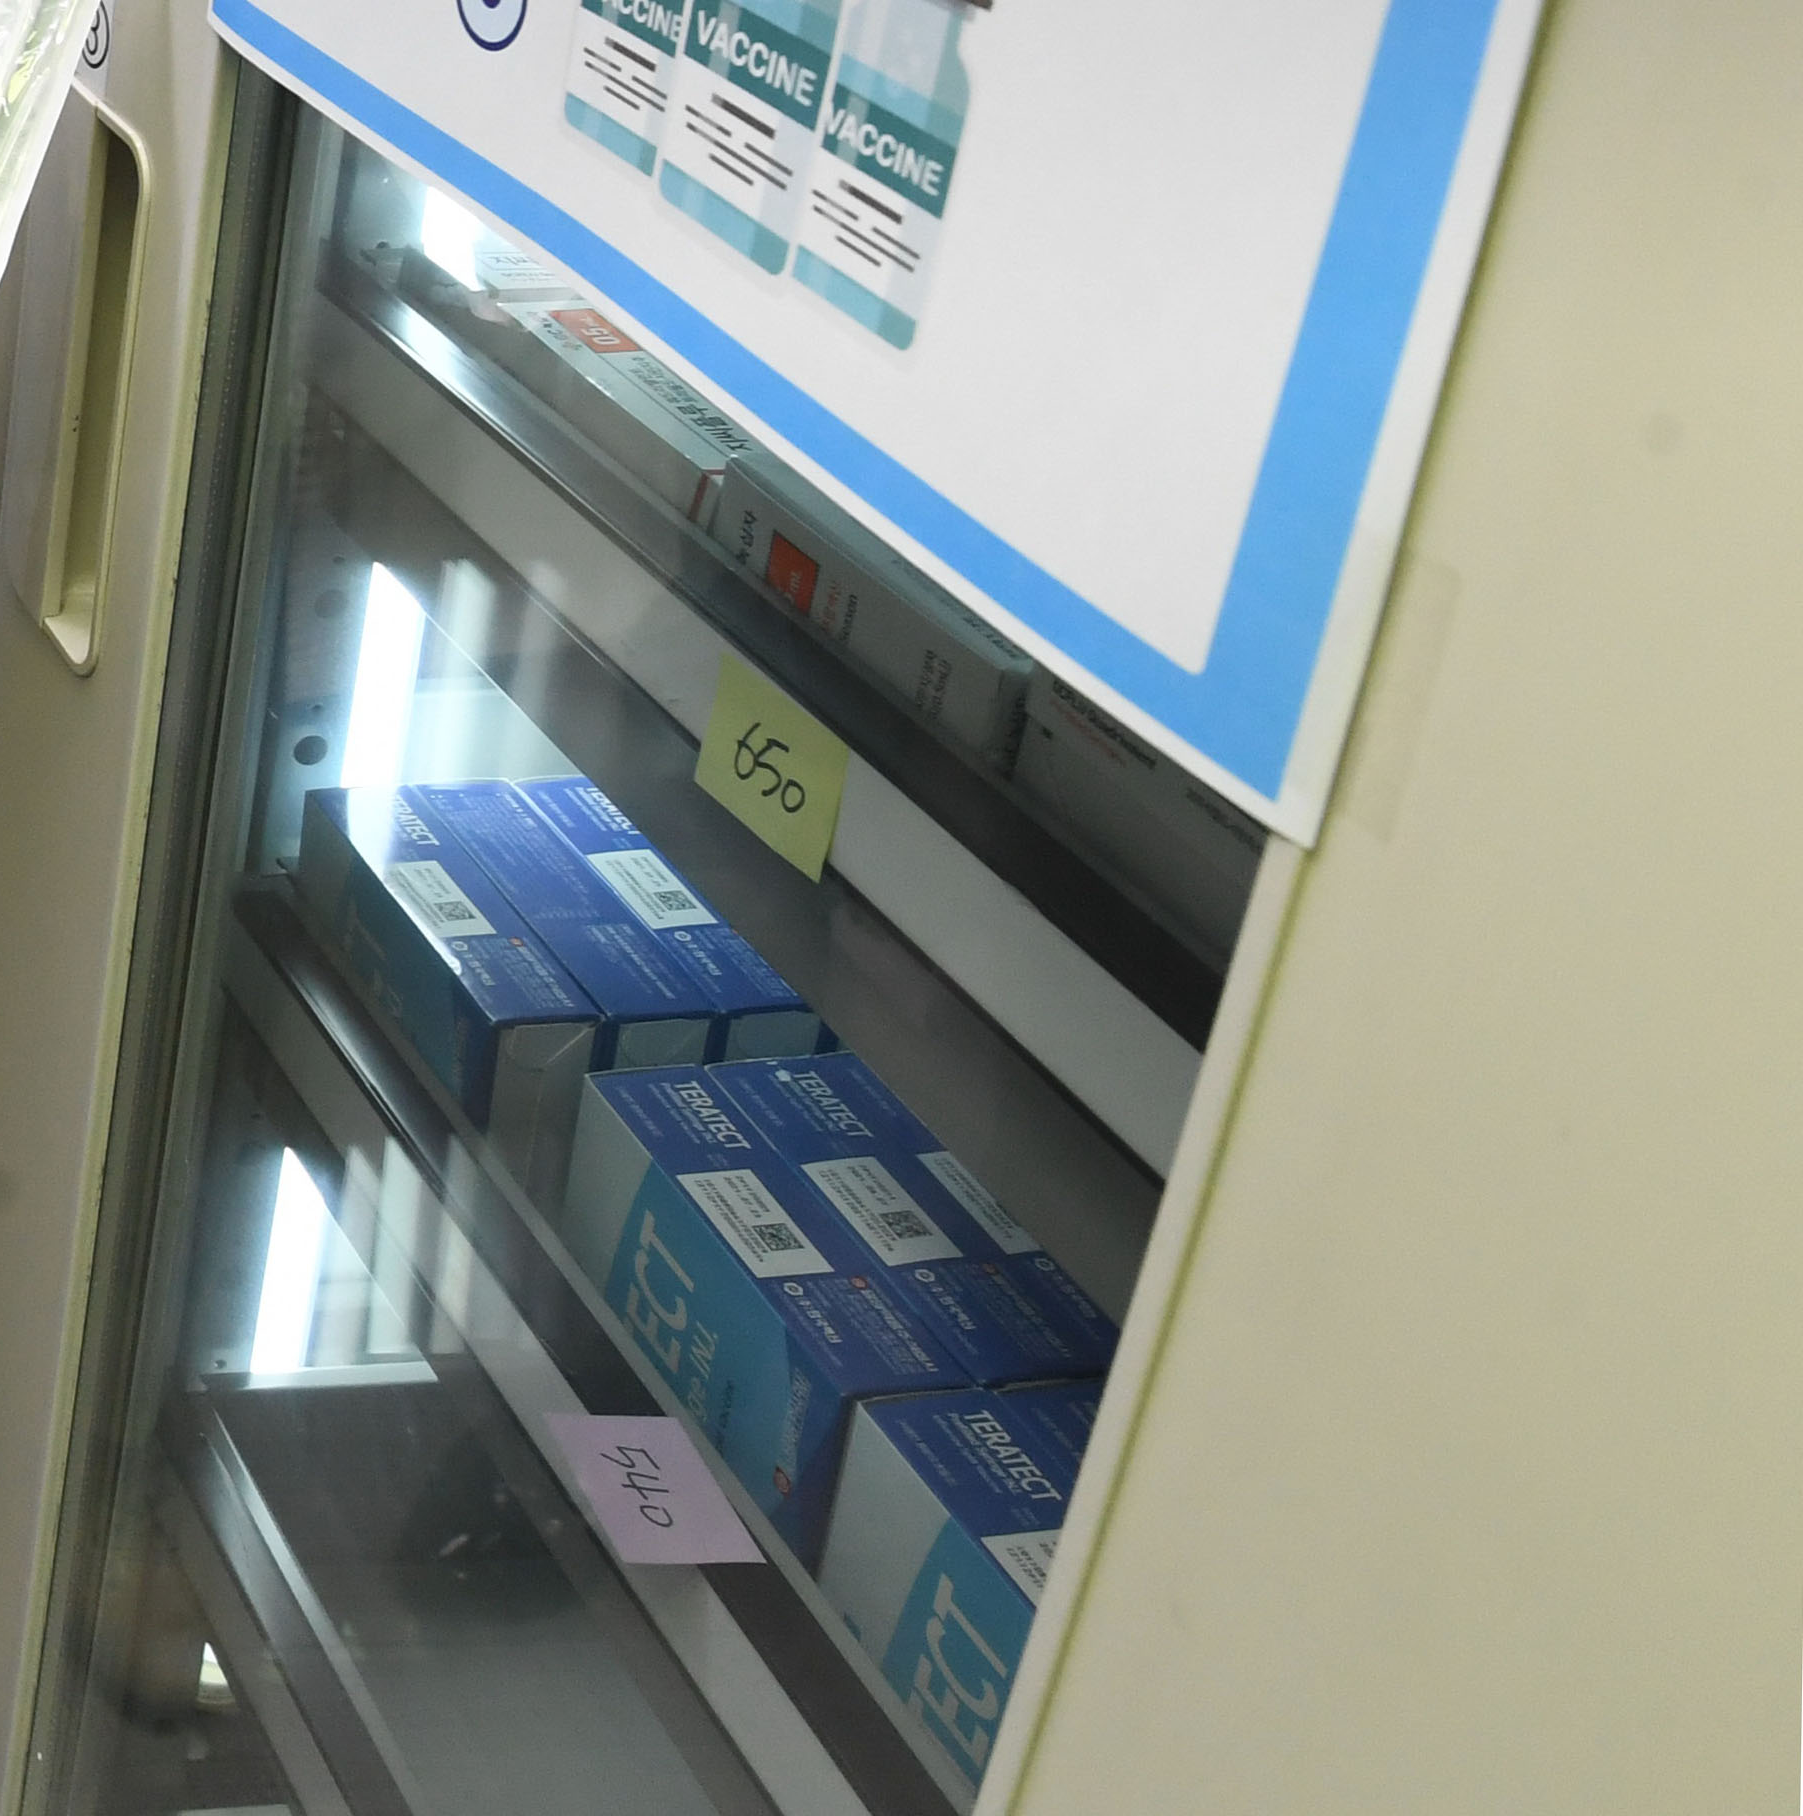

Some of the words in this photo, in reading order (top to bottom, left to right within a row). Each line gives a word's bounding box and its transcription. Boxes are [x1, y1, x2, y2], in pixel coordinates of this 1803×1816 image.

[697, 9, 819, 108] VACCINE
[821, 98, 945, 197] VACCINE
[731, 719, 806, 814] 650
[673, 1080, 752, 1150] TERATECT
[792, 1070, 874, 1139] TERATECT
[599, 1445, 673, 1529] 540
[964, 1410, 1062, 1502] TERATECT
